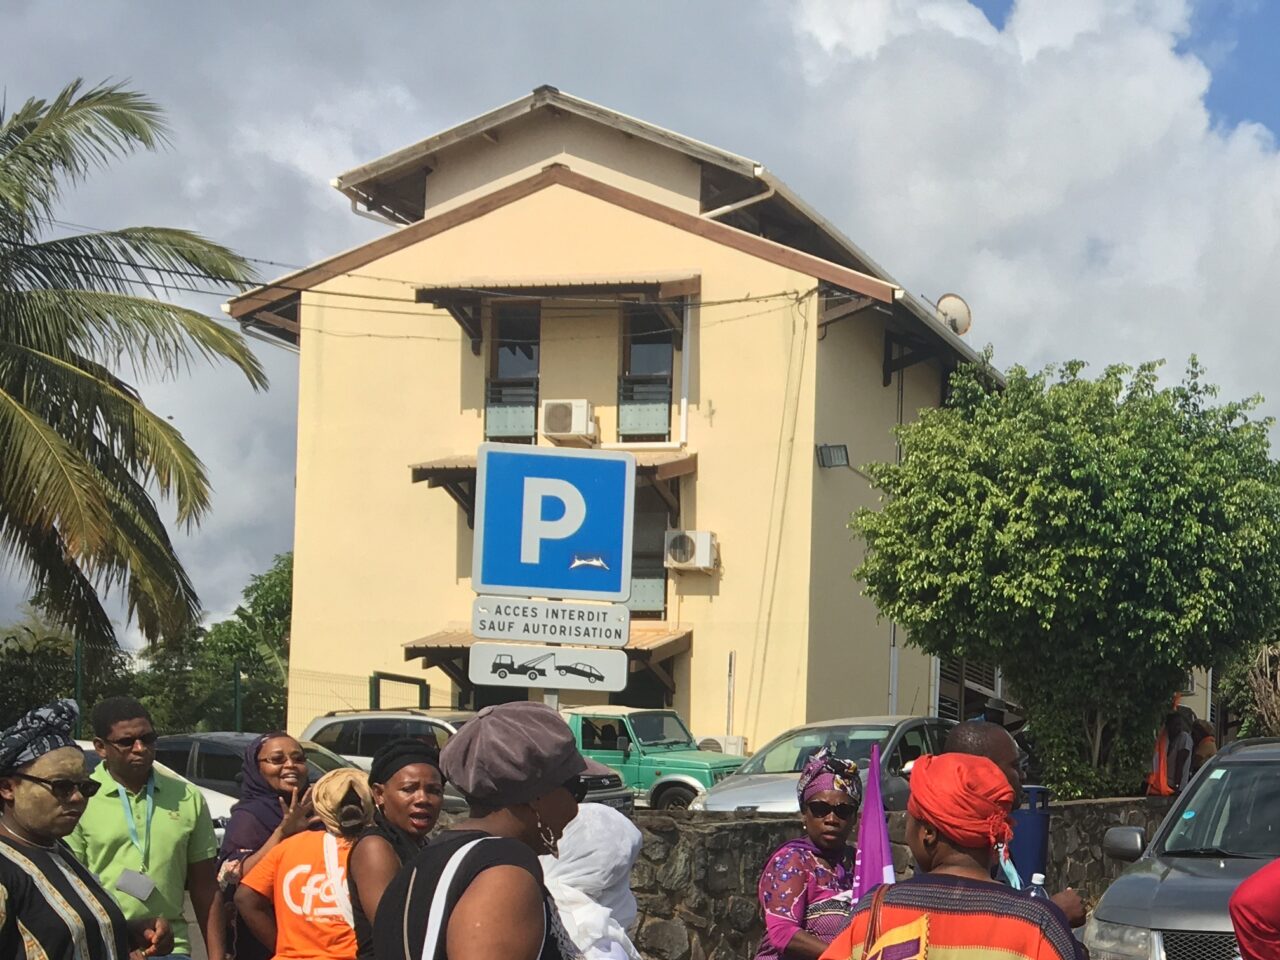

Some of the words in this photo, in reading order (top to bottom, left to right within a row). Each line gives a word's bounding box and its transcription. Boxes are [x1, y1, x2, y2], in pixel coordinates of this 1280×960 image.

[520, 476, 586, 564] P
[494, 604, 538, 618] ACCES
[545, 607, 608, 622] INTERDIT
[478, 619, 515, 632] SAUF
[522, 622, 622, 639] AUTORISATION
